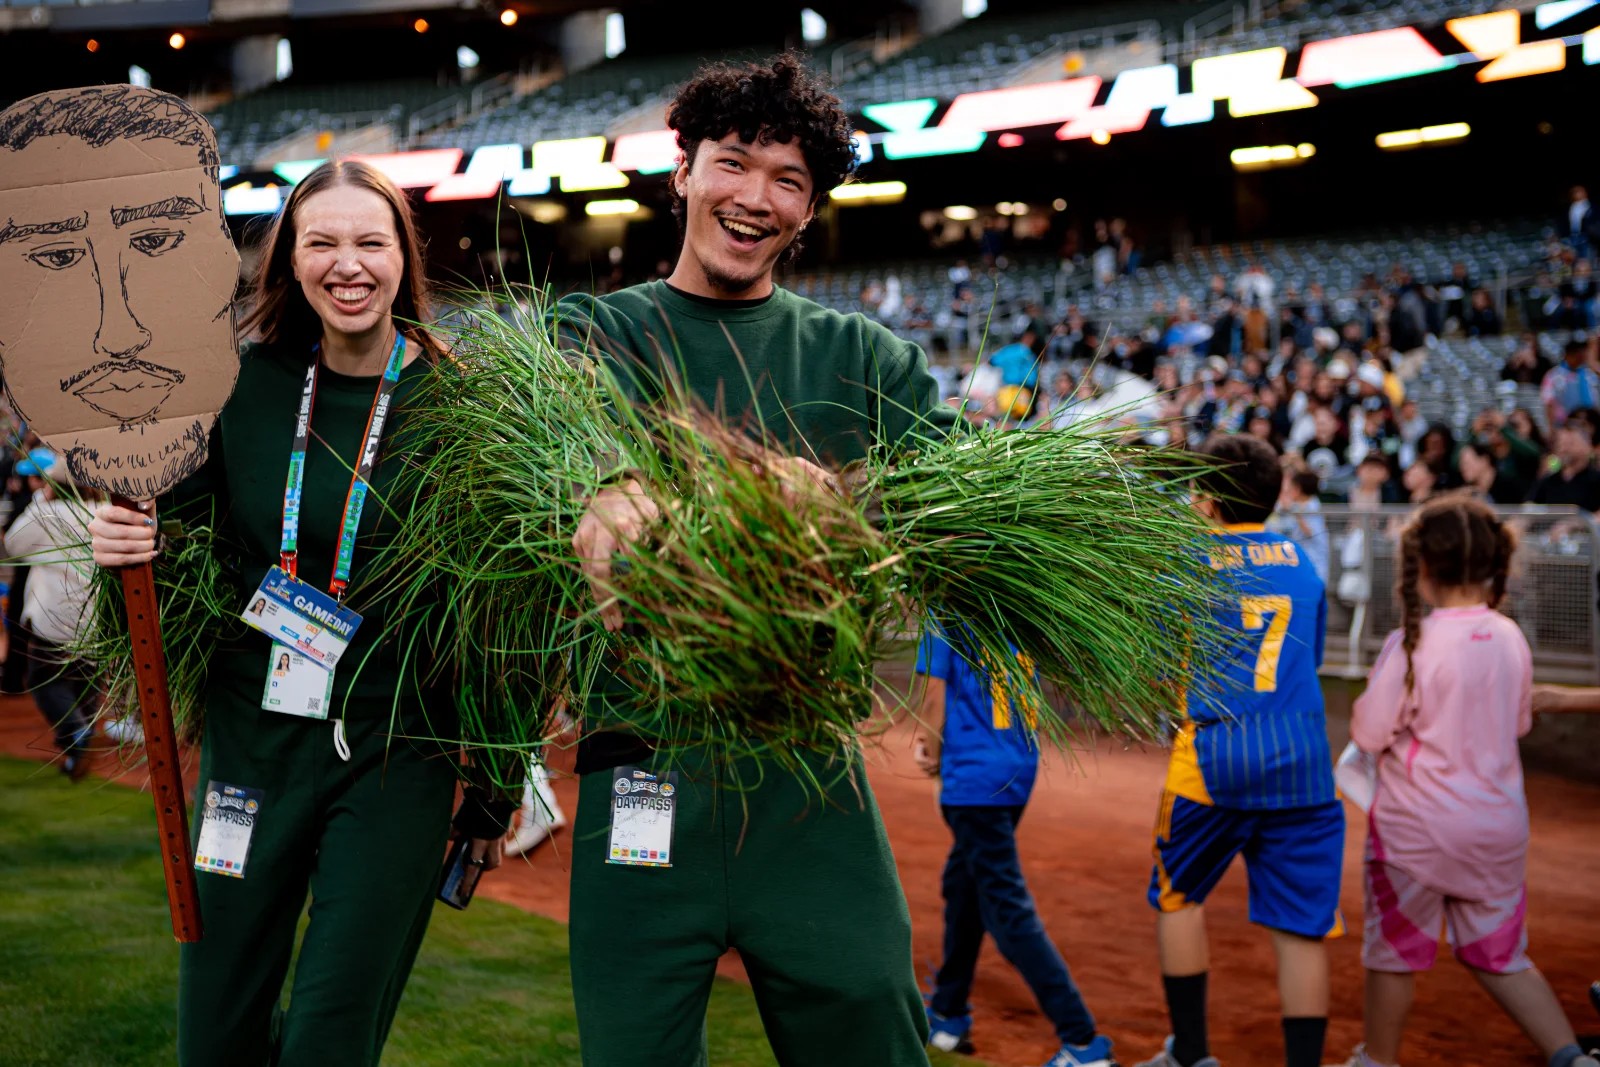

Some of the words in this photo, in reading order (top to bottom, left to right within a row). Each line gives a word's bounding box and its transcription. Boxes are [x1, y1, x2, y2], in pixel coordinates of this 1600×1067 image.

[304, 364, 316, 394] LX
[361, 437, 378, 467] LX
[1246, 541, 1299, 567] OAKS
[294, 595, 353, 636] GAMEDAY
[1241, 595, 1292, 692] 7
[631, 781, 658, 793] 2026
[205, 808, 223, 822] DAY
[224, 811, 254, 827] PASS
[616, 796, 640, 809] DAY
[640, 797, 672, 811] PASS
